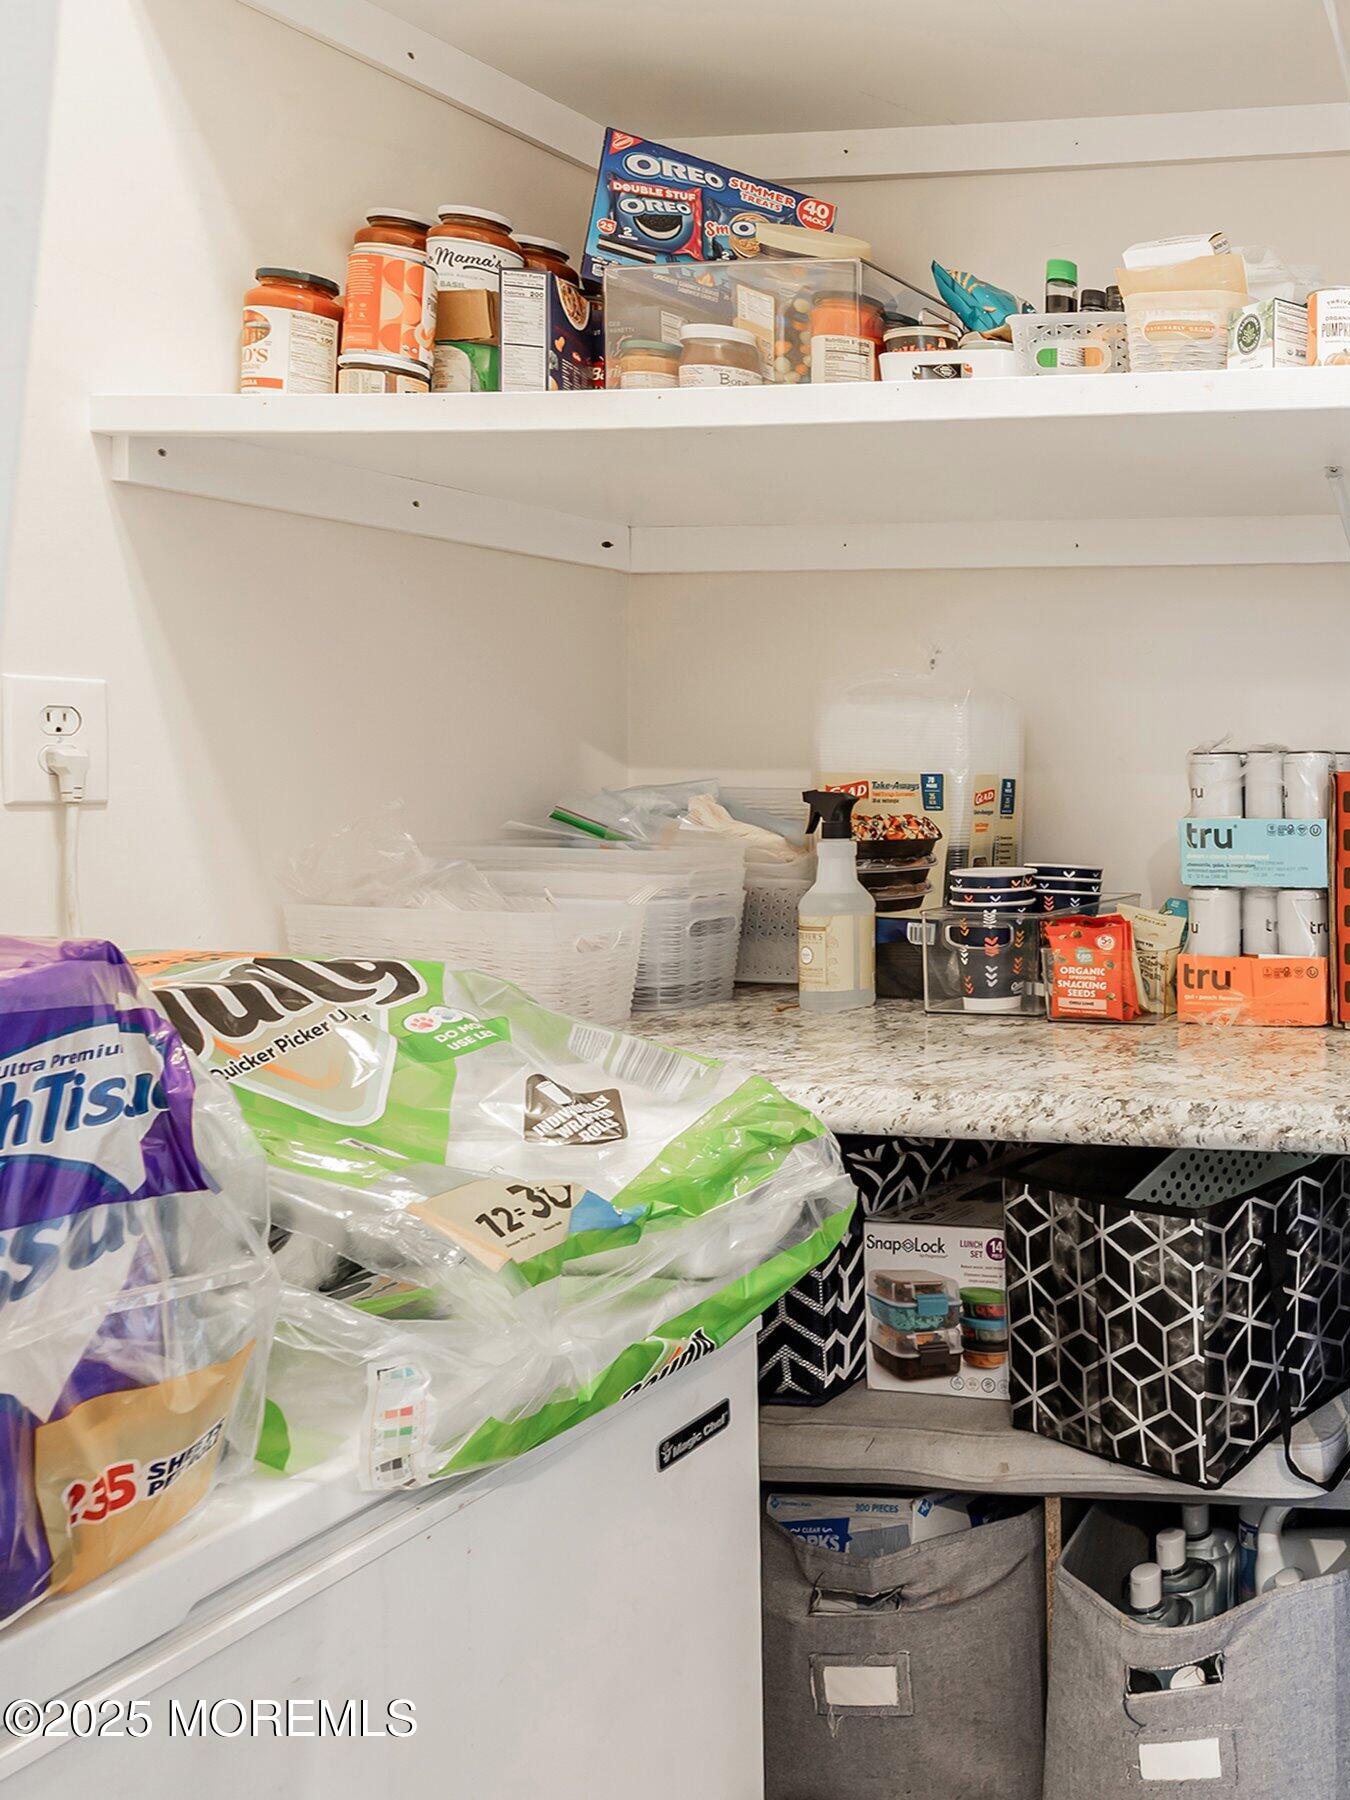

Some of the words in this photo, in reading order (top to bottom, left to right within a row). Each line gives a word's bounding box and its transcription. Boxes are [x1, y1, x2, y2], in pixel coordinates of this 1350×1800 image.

[625, 153, 725, 190] OREO
[612, 182, 664, 199] DOUBLE
[664, 189, 696, 202] STUF
[729, 177, 796, 208] SUMMER
[620, 197, 692, 215] OREO
[741, 192, 783, 213] TREATS
[803, 200, 830, 221] 40
[802, 214, 828, 228] PACKS
[1186, 822, 1233, 849] tru
[1059, 966, 1106, 976] ORGANIC
[1183, 963, 1232, 990] tru
[1057, 979, 1107, 991] SNACKING
[1067, 989, 1096, 998] SEEDS
[274, 1023, 330, 1053] Picker
[434, 1029, 459, 1043] DO
[446, 1036, 477, 1050] USE
[866, 1234, 902, 1254] Snap
[914, 1237, 946, 1254] Lock
[959, 1240, 983, 1248] LUNCH
[989, 1240, 1003, 1253] 14
[969, 1250, 983, 1258] SET
[871, 1503, 899, 1513] PIECES
